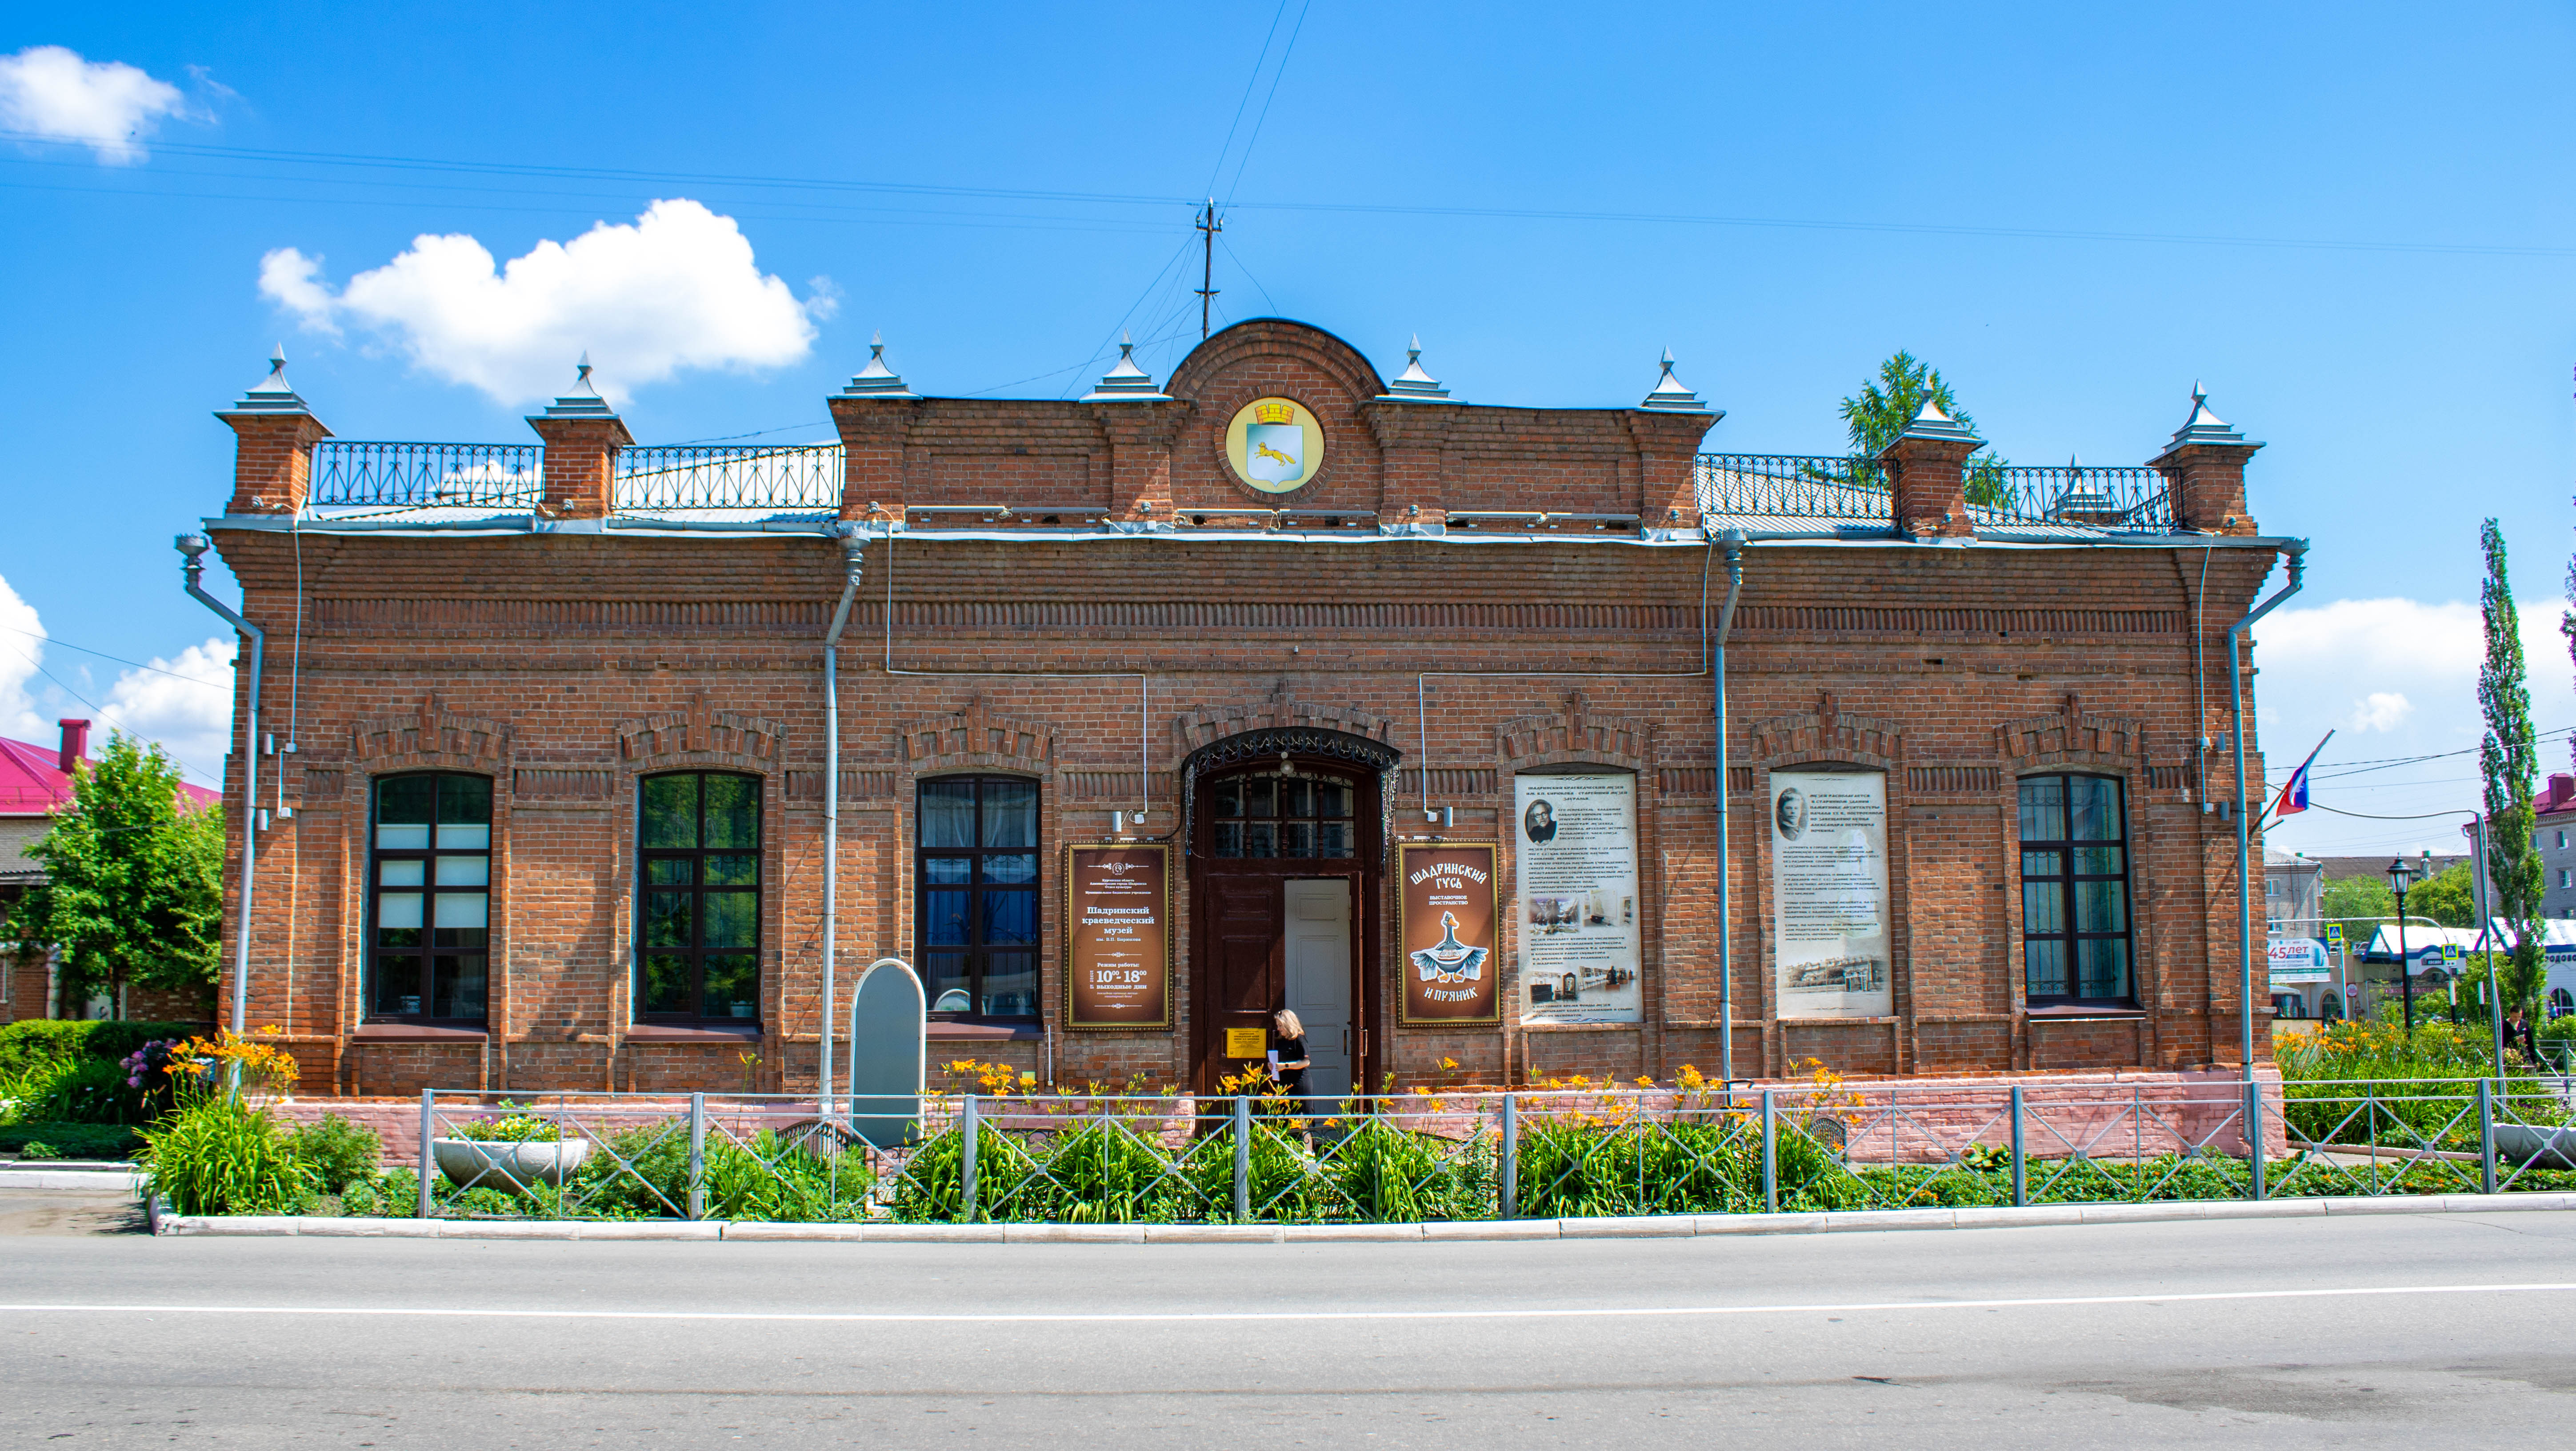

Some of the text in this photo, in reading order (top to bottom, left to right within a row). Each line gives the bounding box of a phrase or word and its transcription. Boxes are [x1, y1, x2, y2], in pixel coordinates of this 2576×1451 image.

[1410, 863, 1487, 885] ШАДРИНСКИЙ
[1436, 877, 1463, 889] ГУСЬ
[1087, 907, 1149, 915] Шадринский
[1082, 916, 1155, 925] краеведческий
[1104, 927, 1133, 935] музей
[2268, 947, 2286, 959] 45
[1424, 987, 1478, 1002] И ПРЯНИК
